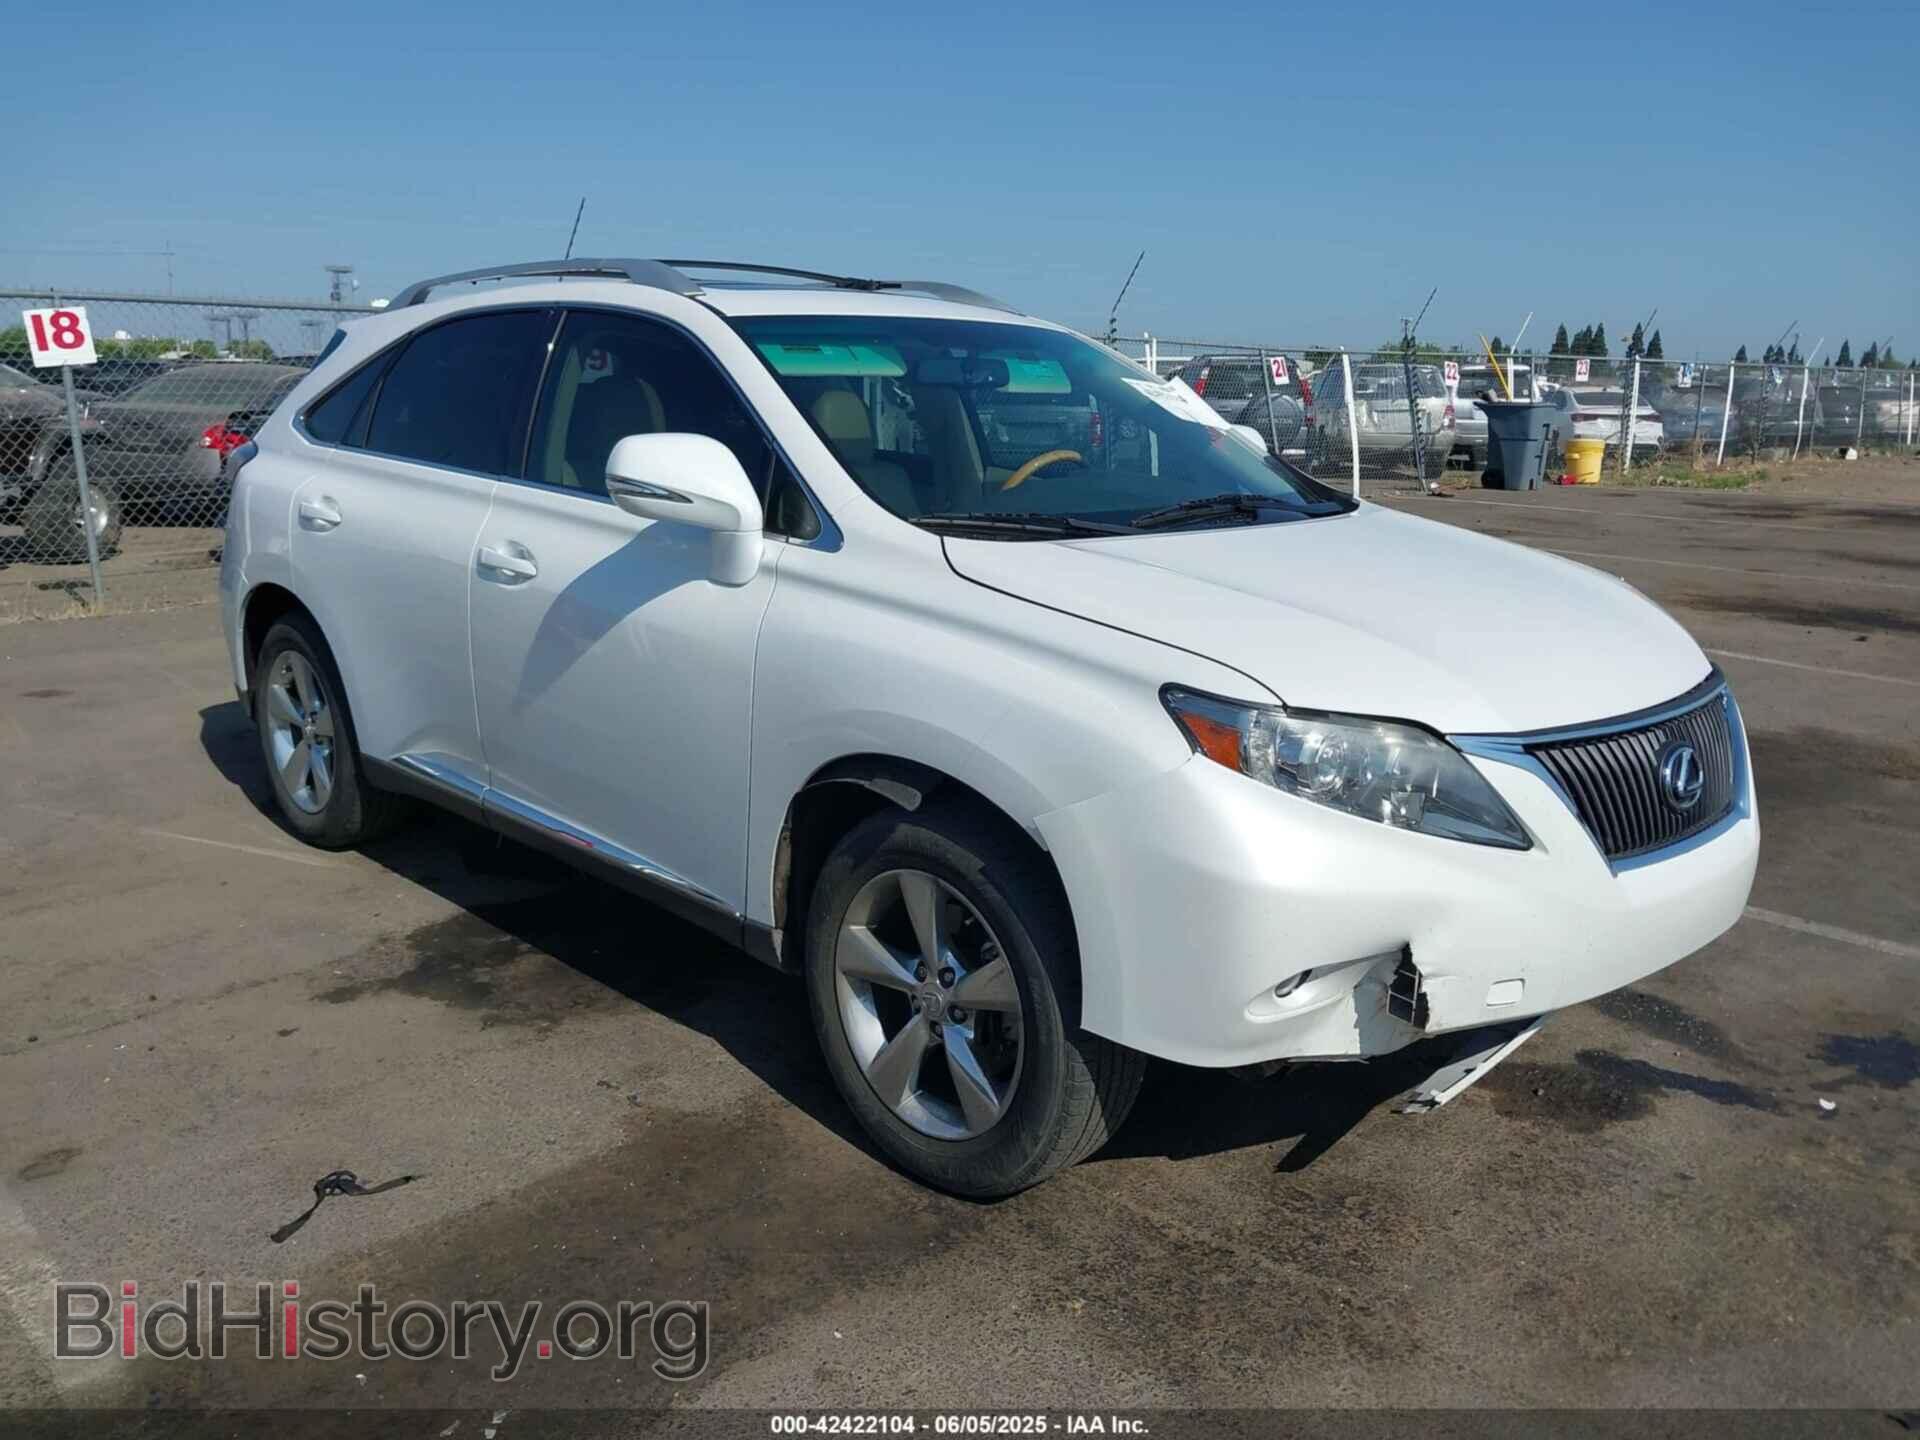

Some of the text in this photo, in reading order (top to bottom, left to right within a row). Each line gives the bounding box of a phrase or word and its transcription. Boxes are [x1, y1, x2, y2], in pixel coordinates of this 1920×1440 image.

[31, 311, 85, 351] 18
[1273, 360, 1287, 377] 21
[1446, 363, 1458, 380] 22
